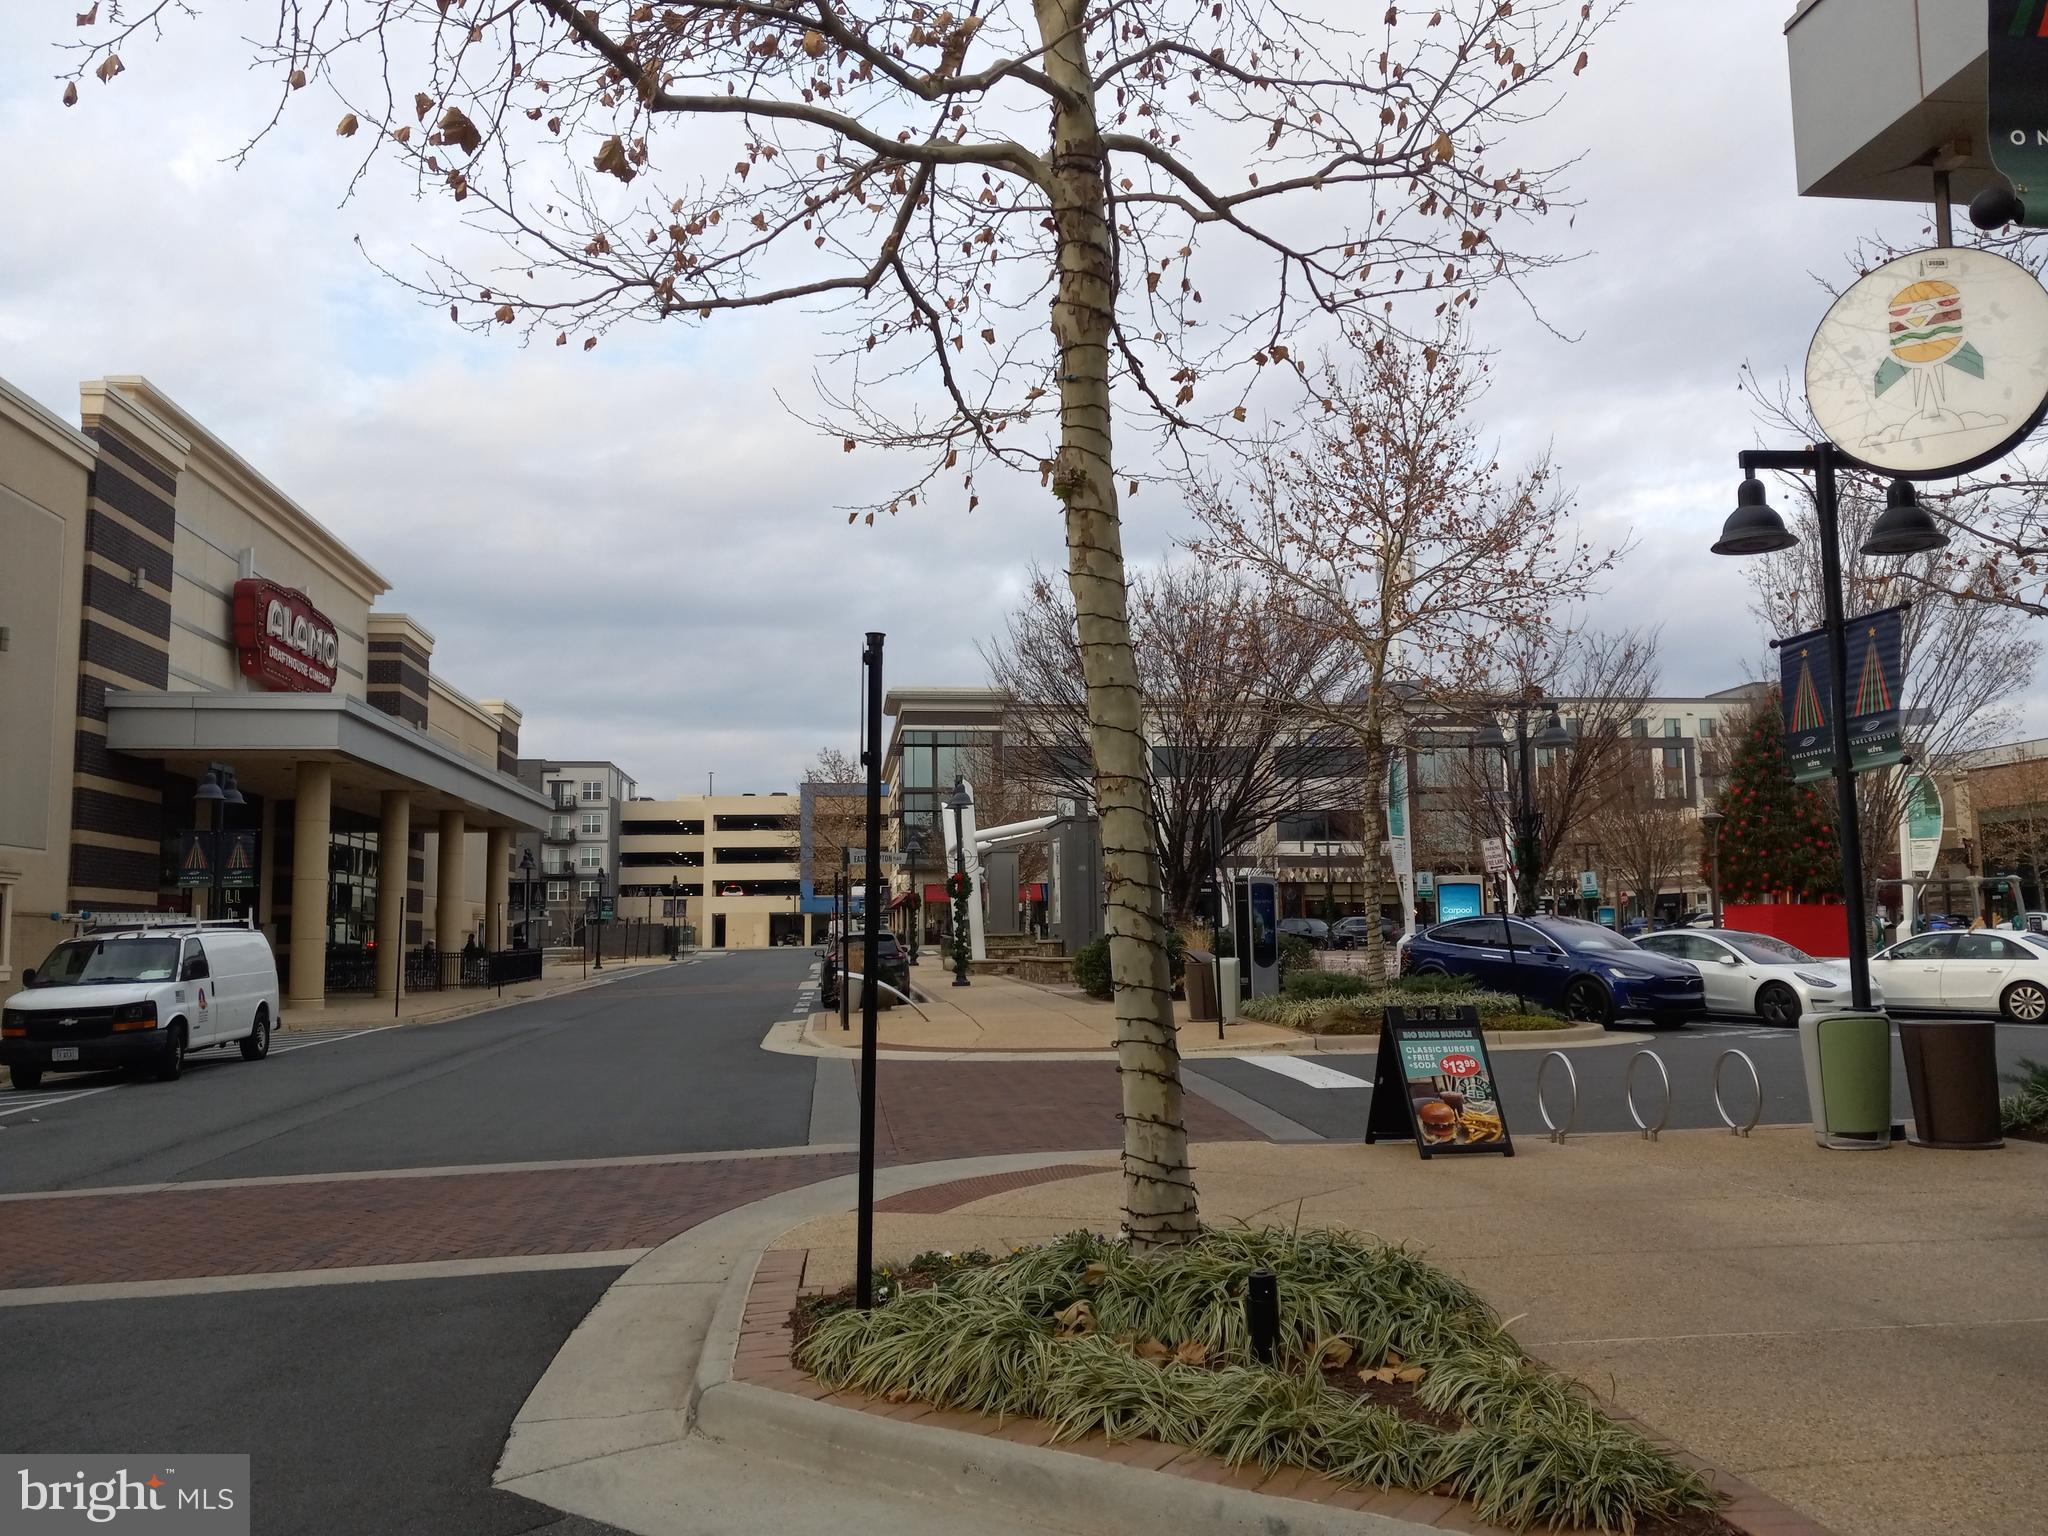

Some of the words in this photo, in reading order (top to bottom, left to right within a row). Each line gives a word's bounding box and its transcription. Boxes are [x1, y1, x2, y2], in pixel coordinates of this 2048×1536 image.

[266, 599, 338, 669] ALAMO
[268, 644, 309, 677] DRAFTHOUSE
[308, 667, 331, 688] CINEMA
[1442, 906, 1473, 915] Carpool
[1440, 1030, 1473, 1039] BUNDLE
[1442, 1045, 1476, 1053] BURGER
